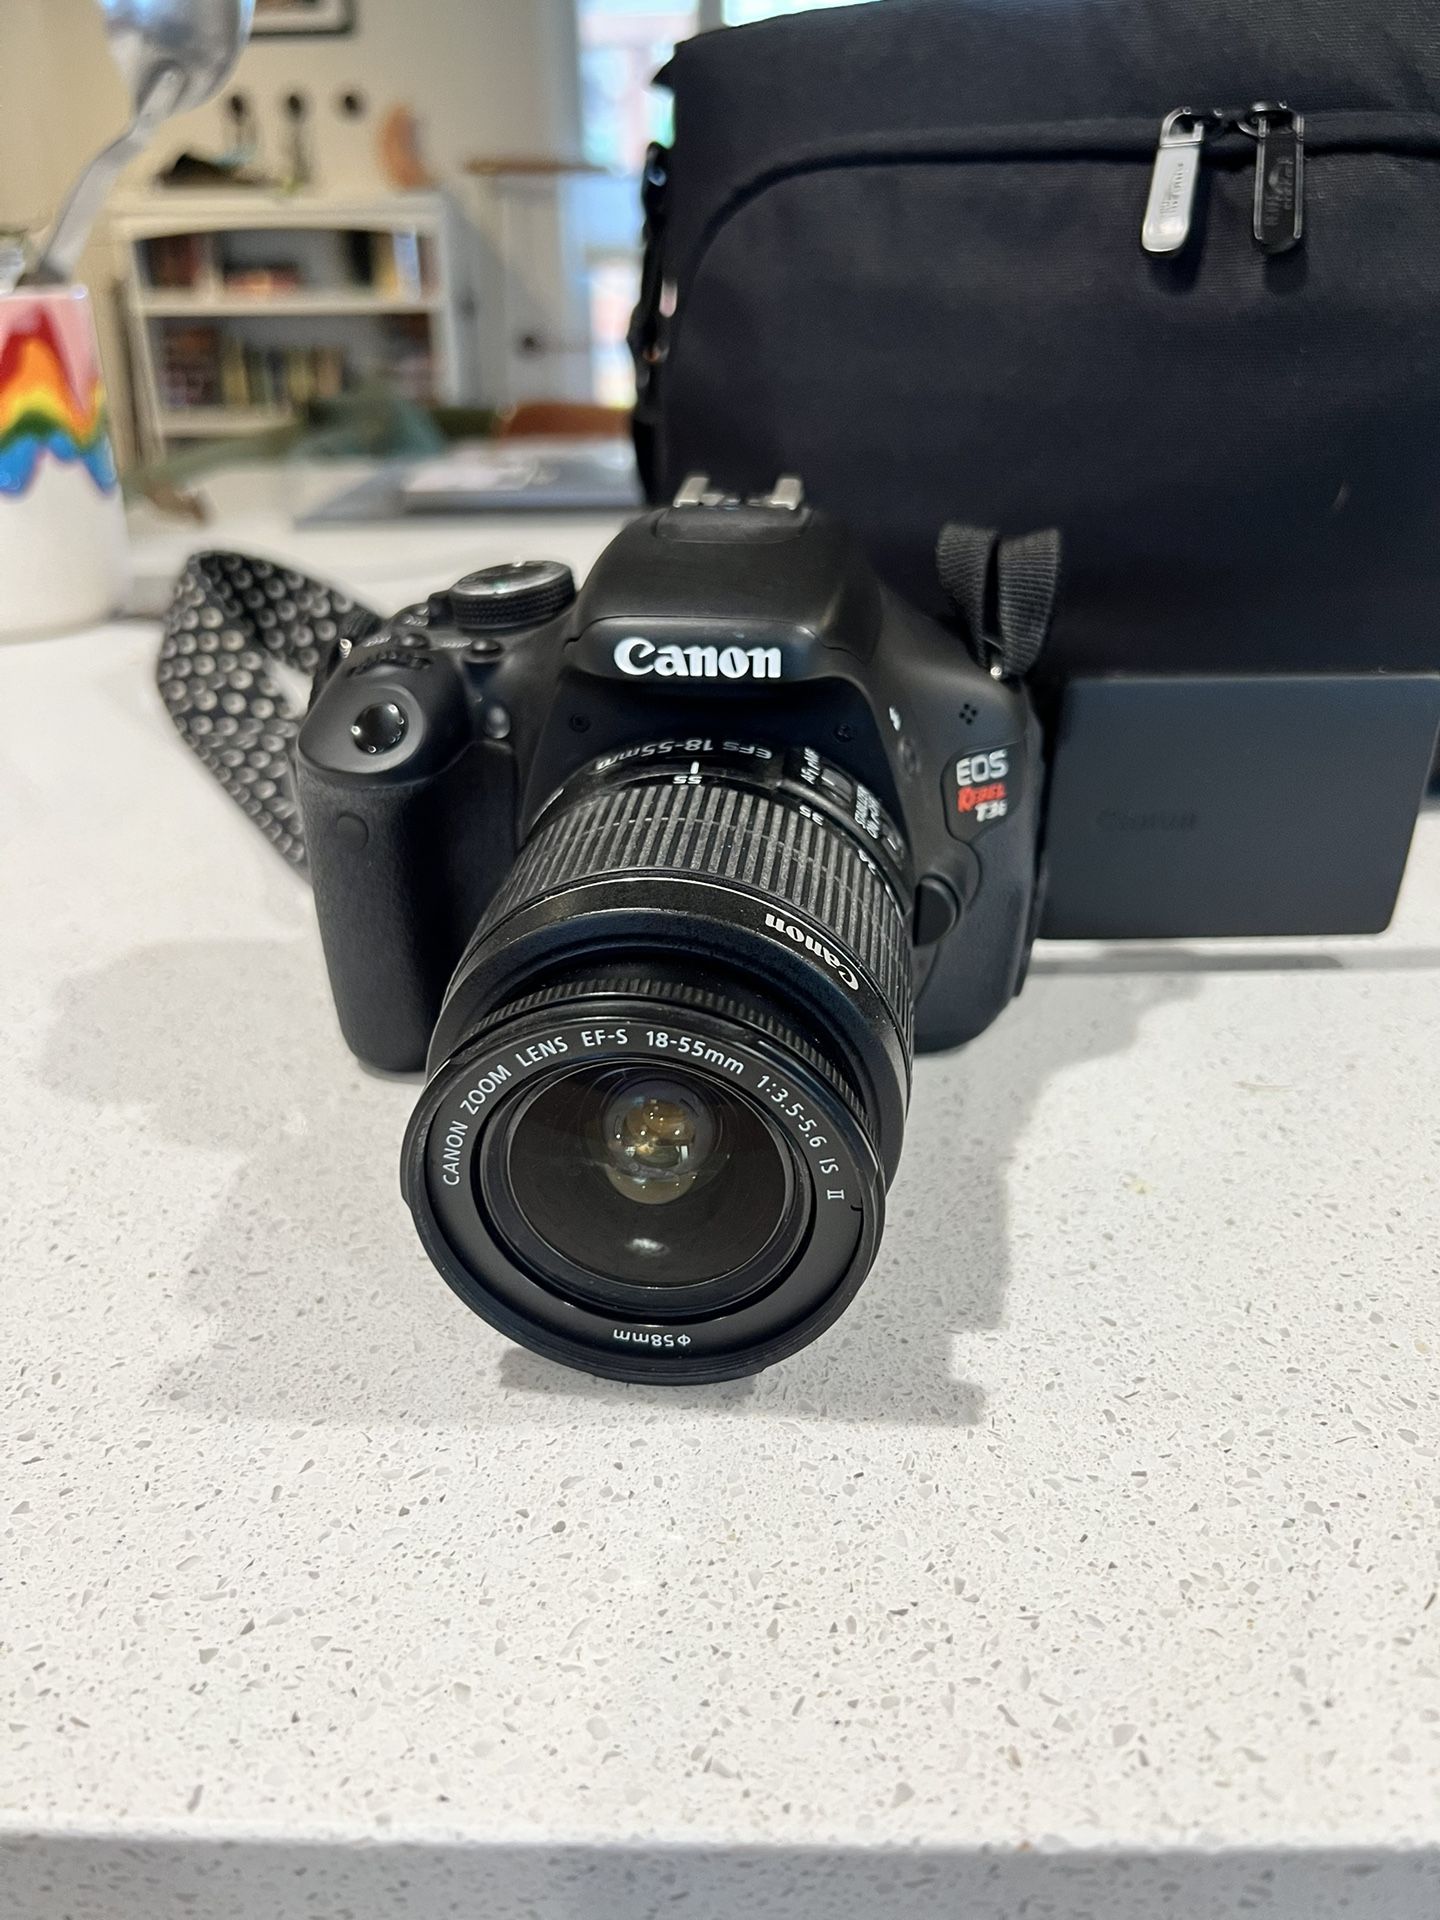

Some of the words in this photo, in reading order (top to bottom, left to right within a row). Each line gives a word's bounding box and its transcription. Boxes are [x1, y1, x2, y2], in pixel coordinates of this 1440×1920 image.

[613, 637, 781, 678] Canon
[595, 738, 713, 771] 18-55mm
[956, 748, 1009, 786] EOS
[673, 774, 702, 785] 55
[799, 804, 824, 825] 35
[765, 913, 859, 991] Canon
[443, 1120, 468, 1186] CANON
[460, 1064, 512, 1115] ZOOM
[515, 1036, 568, 1067] LENS
[581, 1028, 628, 1047] EF-S
[646, 1030, 745, 1075] 18-55mm
[756, 1075, 827, 1148] 1:3.5-5.6
[819, 1158, 839, 1174] IS
